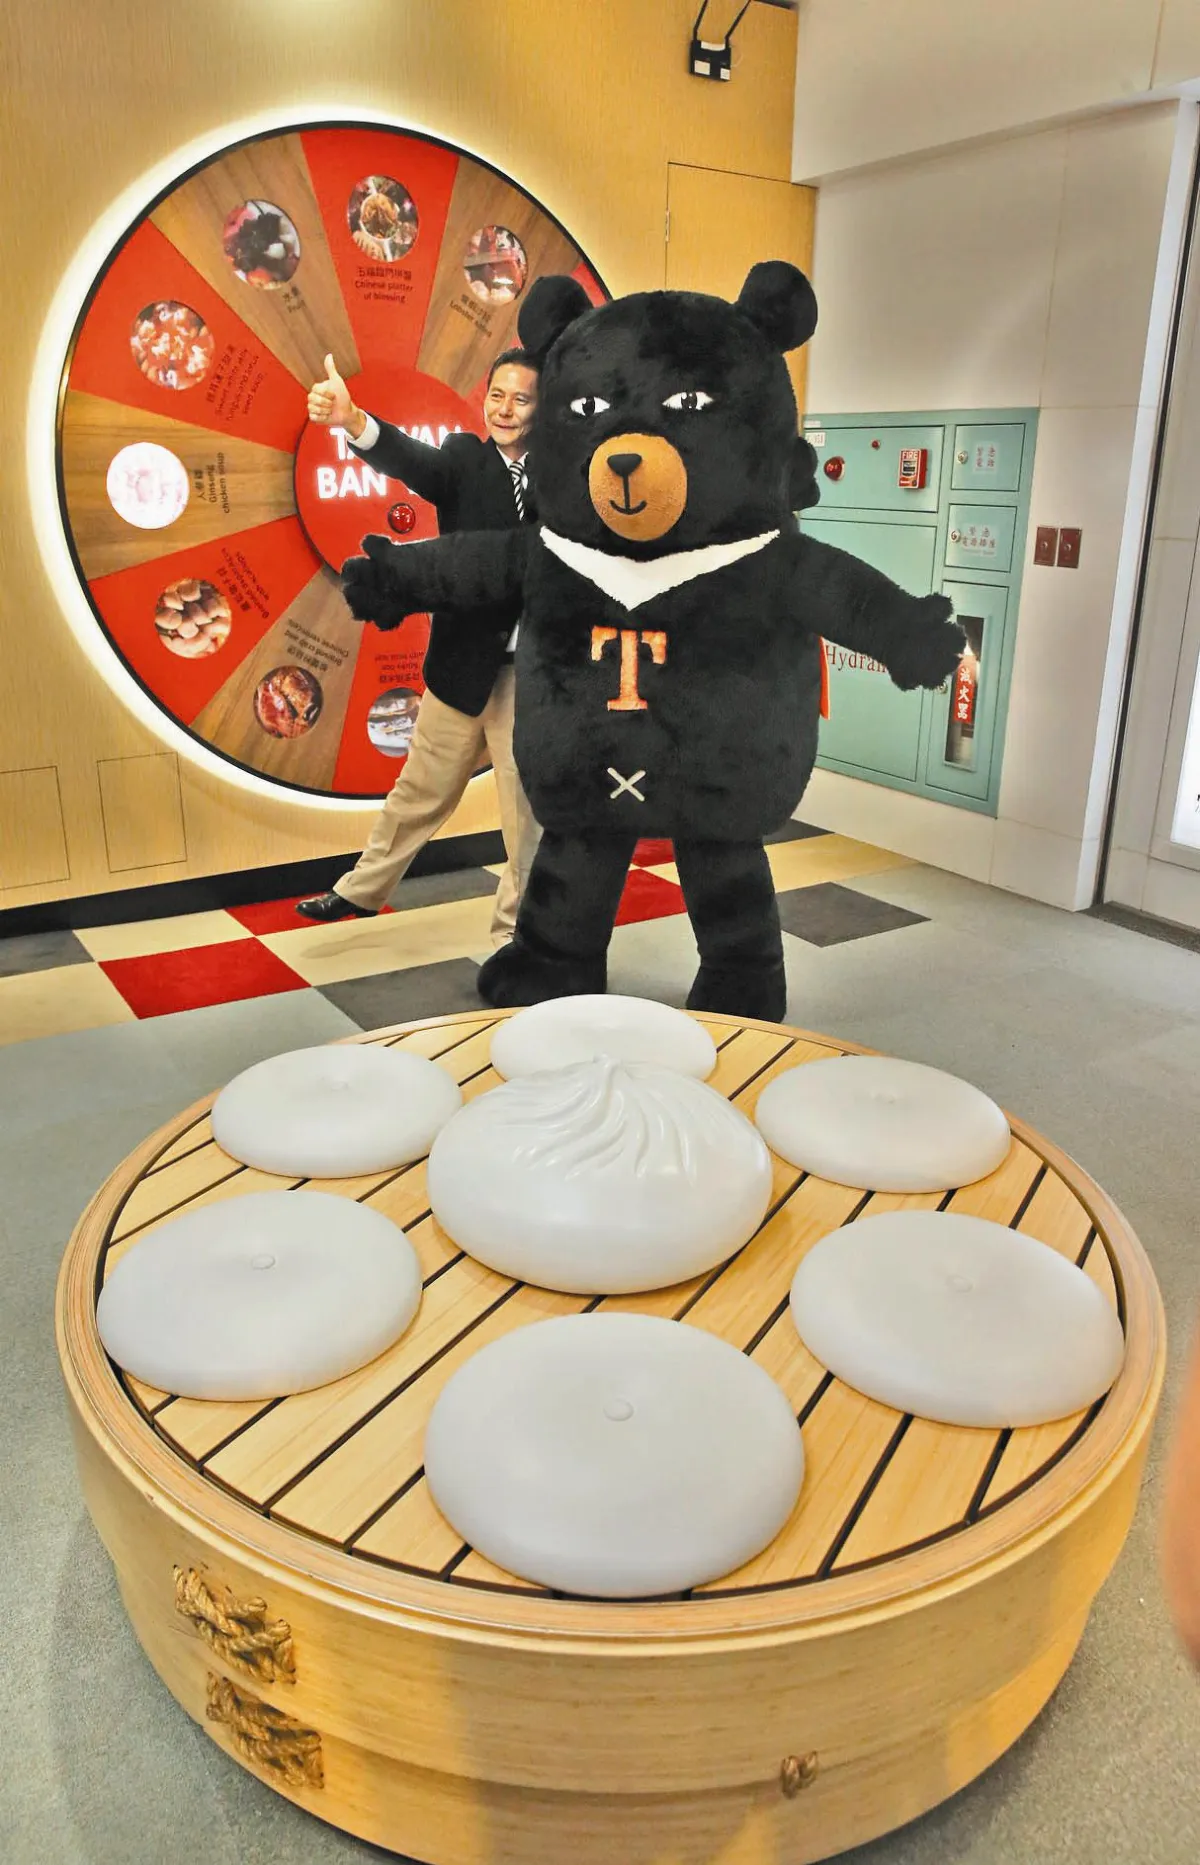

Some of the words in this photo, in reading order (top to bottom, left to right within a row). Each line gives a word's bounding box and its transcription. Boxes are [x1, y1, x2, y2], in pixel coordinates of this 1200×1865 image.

[217, 452, 226, 475] soup
[902, 451, 918, 459] FIRE
[206, 464, 217, 503] Ginseng
[219, 478, 230, 514] chicken
[316, 466, 387, 499] BAN
[591, 625, 667, 711] T
[825, 644, 887, 673] Hydran
